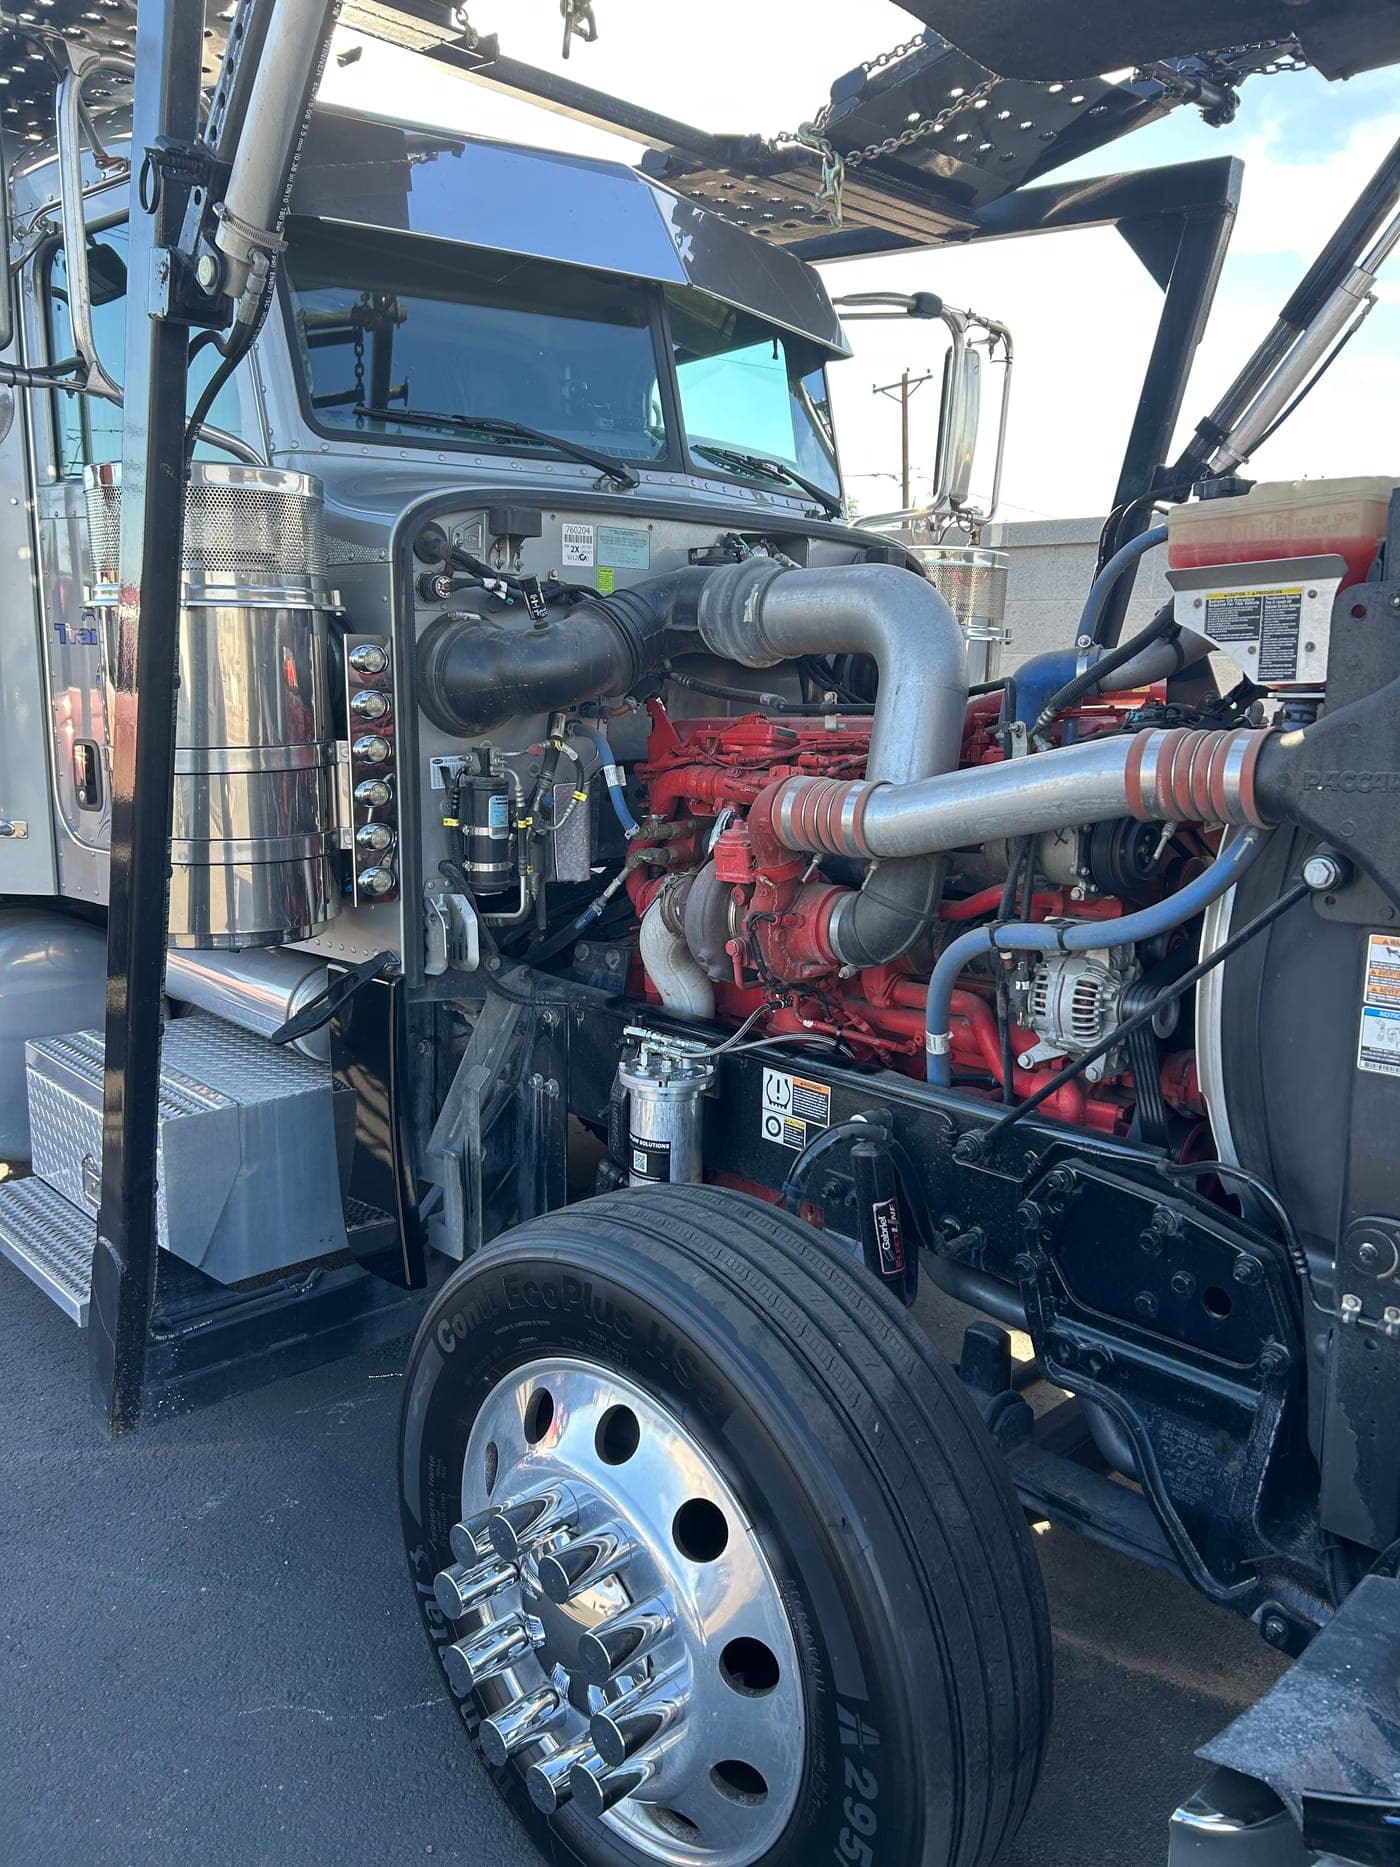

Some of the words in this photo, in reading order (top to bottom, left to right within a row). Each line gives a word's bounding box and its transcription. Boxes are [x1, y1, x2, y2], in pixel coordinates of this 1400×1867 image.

[566, 525, 591, 535] 760204
[640, 1140, 670, 1149] SOLUTIONS
[878, 1216, 891, 1250] Gabriel
